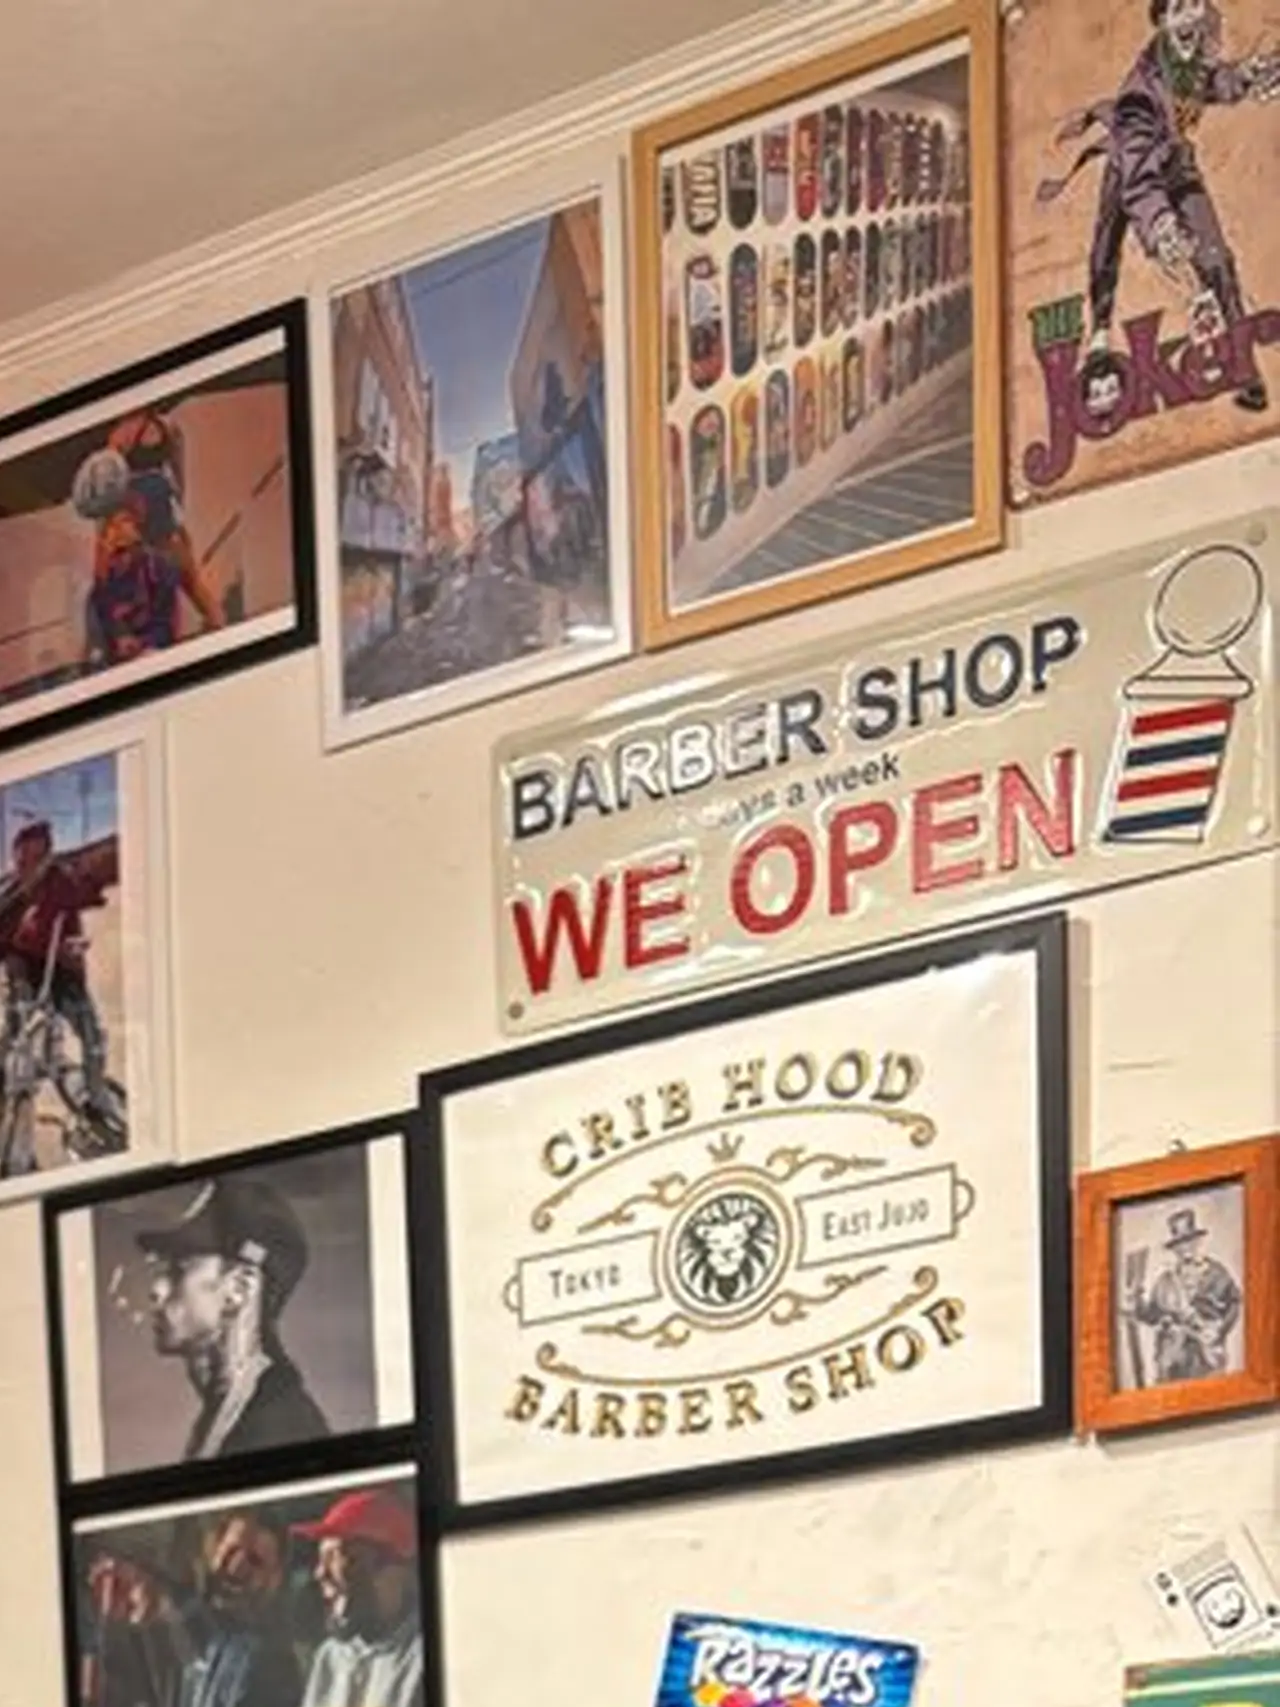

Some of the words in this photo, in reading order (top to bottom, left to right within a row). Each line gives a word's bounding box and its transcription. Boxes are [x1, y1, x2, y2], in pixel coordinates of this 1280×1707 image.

[512, 688, 829, 840] BARBER
[853, 615, 1081, 742] SHOP
[813, 751, 900, 799] week
[511, 853, 691, 996] WE
[729, 746, 1078, 937] OPEN
[539, 1075, 694, 1180] CRIB
[721, 1048, 926, 1114] HOOD
[503, 1374, 766, 1440] BARBER
[785, 1296, 968, 1416] SHOP
[684, 1624, 883, 1707] Razzles
